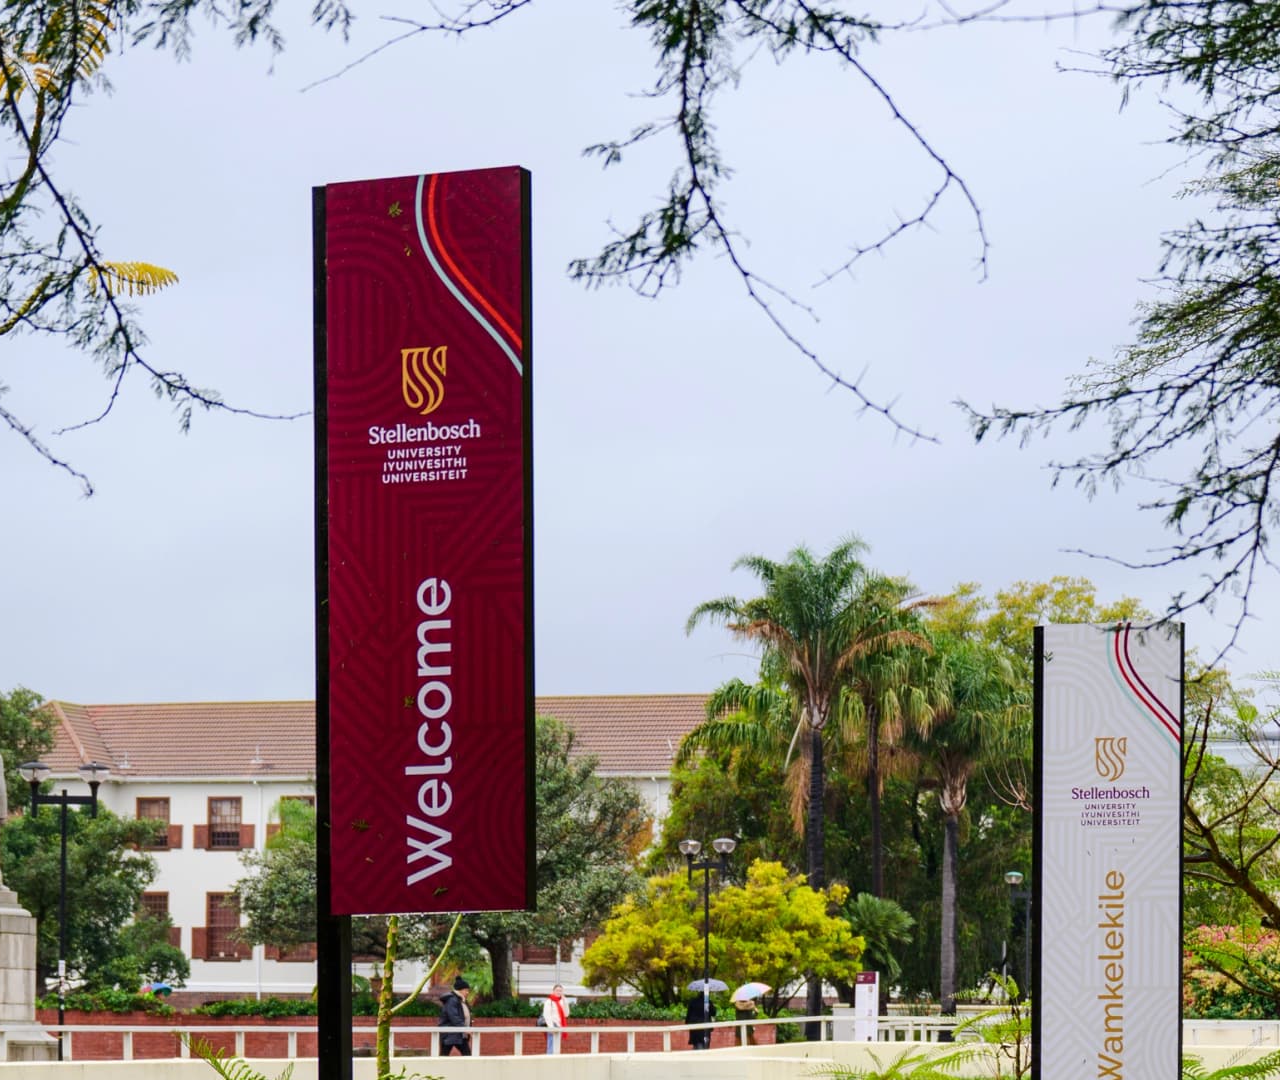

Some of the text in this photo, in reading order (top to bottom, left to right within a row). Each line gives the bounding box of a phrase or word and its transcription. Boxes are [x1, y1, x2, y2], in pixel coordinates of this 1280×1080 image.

[368, 418, 481, 445] Stellenbosch
[387, 445, 462, 460] UNIVERSITY
[383, 457, 467, 472] IYUNIVESITHI
[382, 469, 468, 484] UNIVERSITEIT
[405, 577, 453, 886] Welcome
[1071, 786, 1150, 800] Stellenbosch
